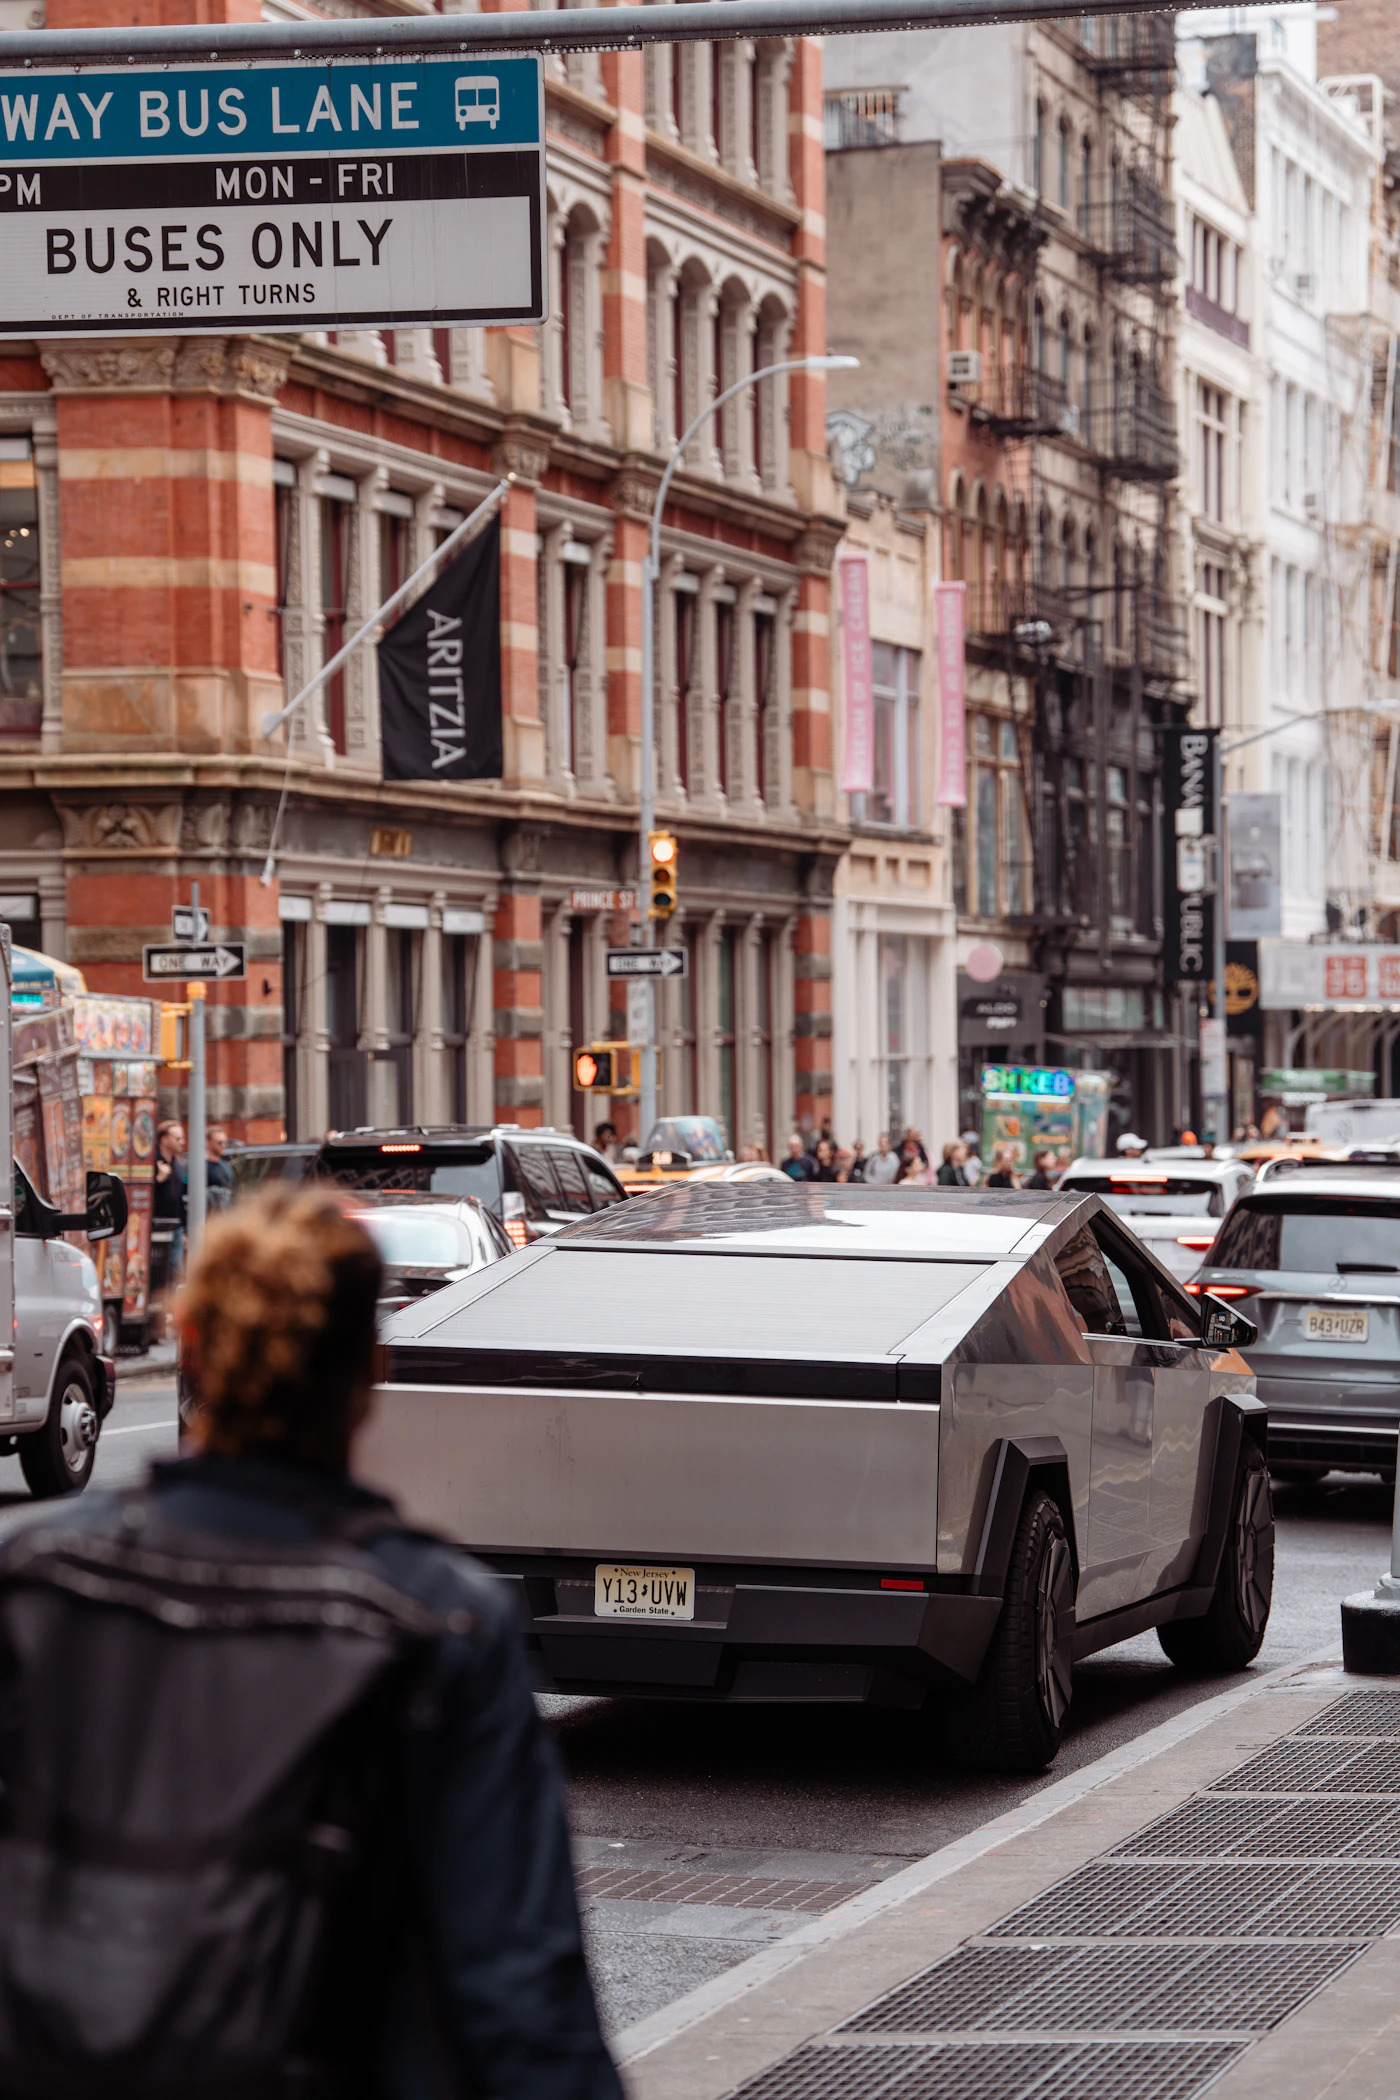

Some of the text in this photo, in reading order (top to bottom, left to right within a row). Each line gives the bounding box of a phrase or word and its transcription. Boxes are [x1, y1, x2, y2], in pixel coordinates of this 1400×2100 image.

[1, 81, 419, 141] WAY BUS LANE
[215, 165, 294, 199] MON
[338, 162, 393, 196] FRI
[46, 218, 393, 275] BUSES ONLY
[127, 283, 316, 308] & RIGHT TURNS
[98, 311, 185, 319] TRANSPORTATION
[426, 608, 467, 770] ARITZIA
[572, 889, 635, 909] PRINCE ST
[158, 955, 228, 969] ONE WAY
[620, 1567, 670, 1579] New Jersey
[619, 1605, 670, 1615] Garden State
